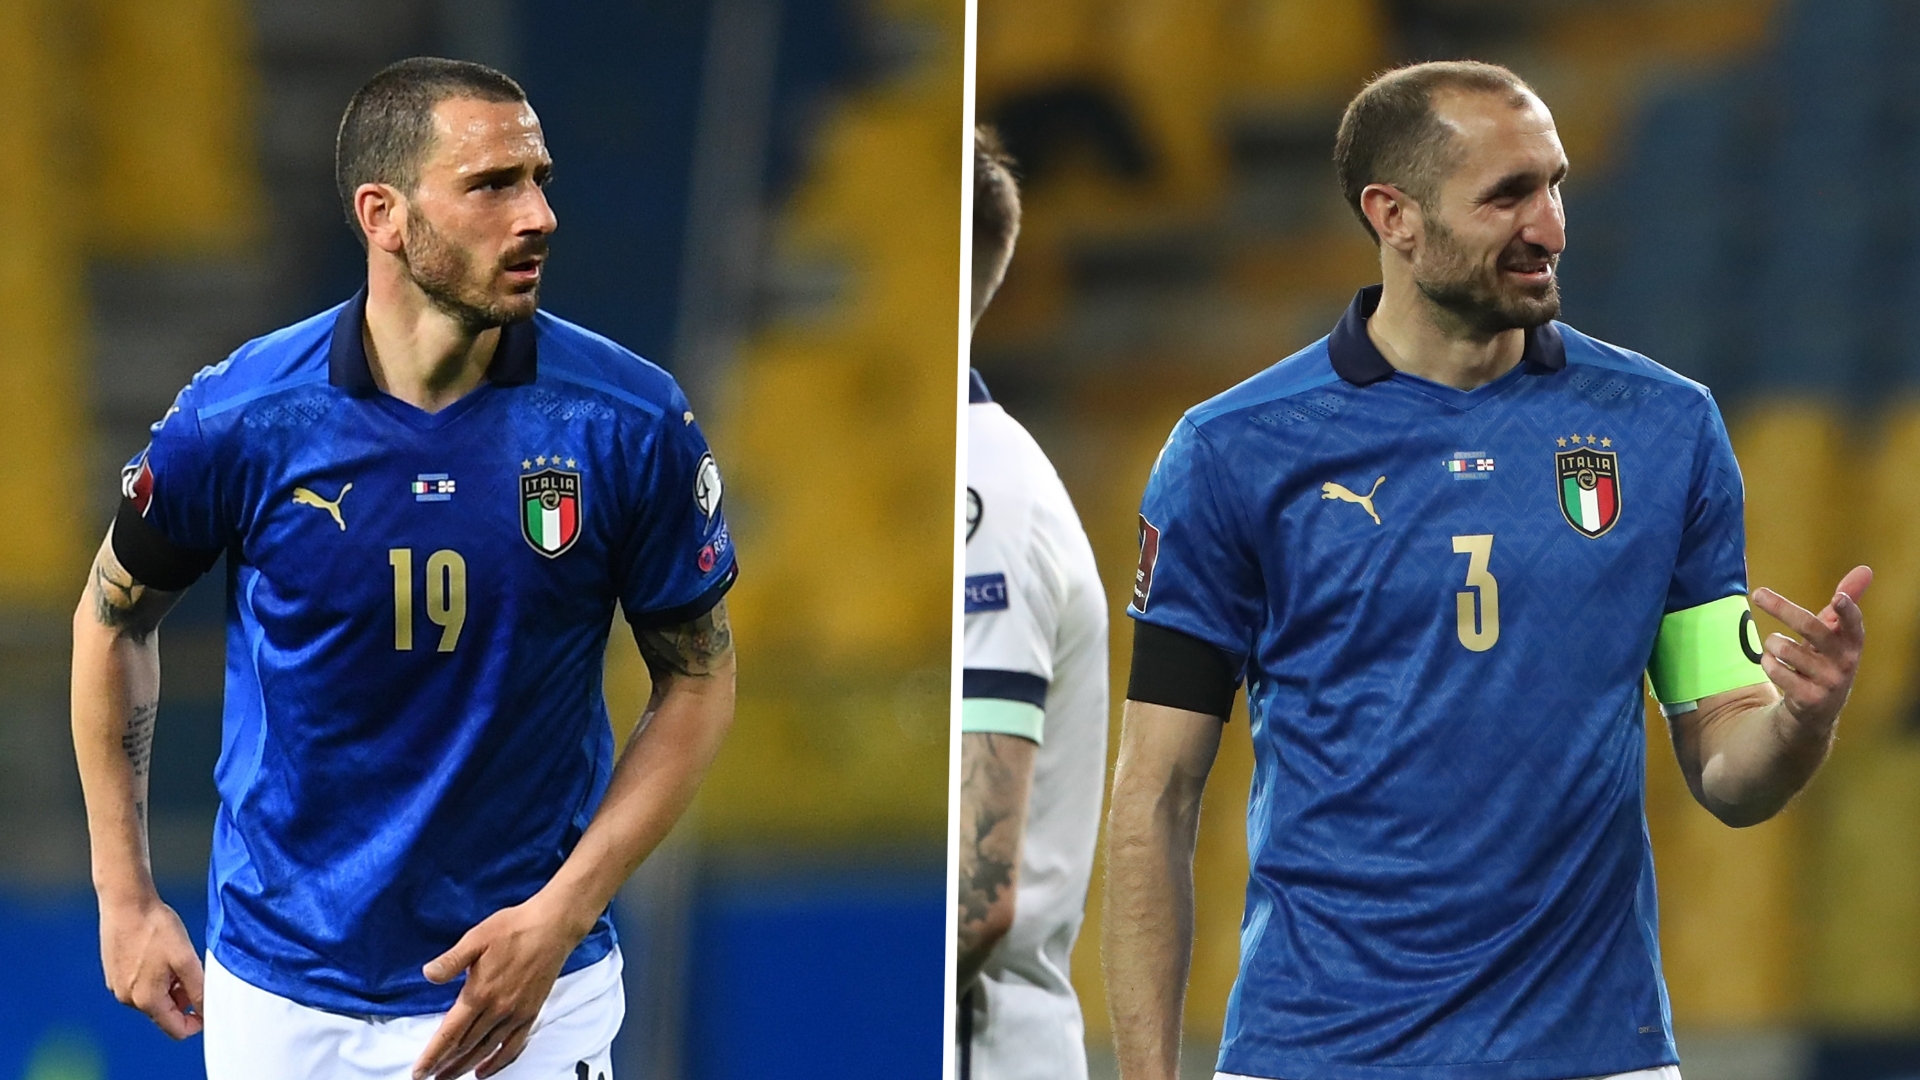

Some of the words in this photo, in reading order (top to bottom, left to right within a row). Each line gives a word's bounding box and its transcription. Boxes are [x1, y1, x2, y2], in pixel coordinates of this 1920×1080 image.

[525, 476, 575, 492] ITALIA
[1562, 456, 1611, 470] ITALIA
[389, 548, 467, 653] 19
[1452, 534, 1500, 652] 3
